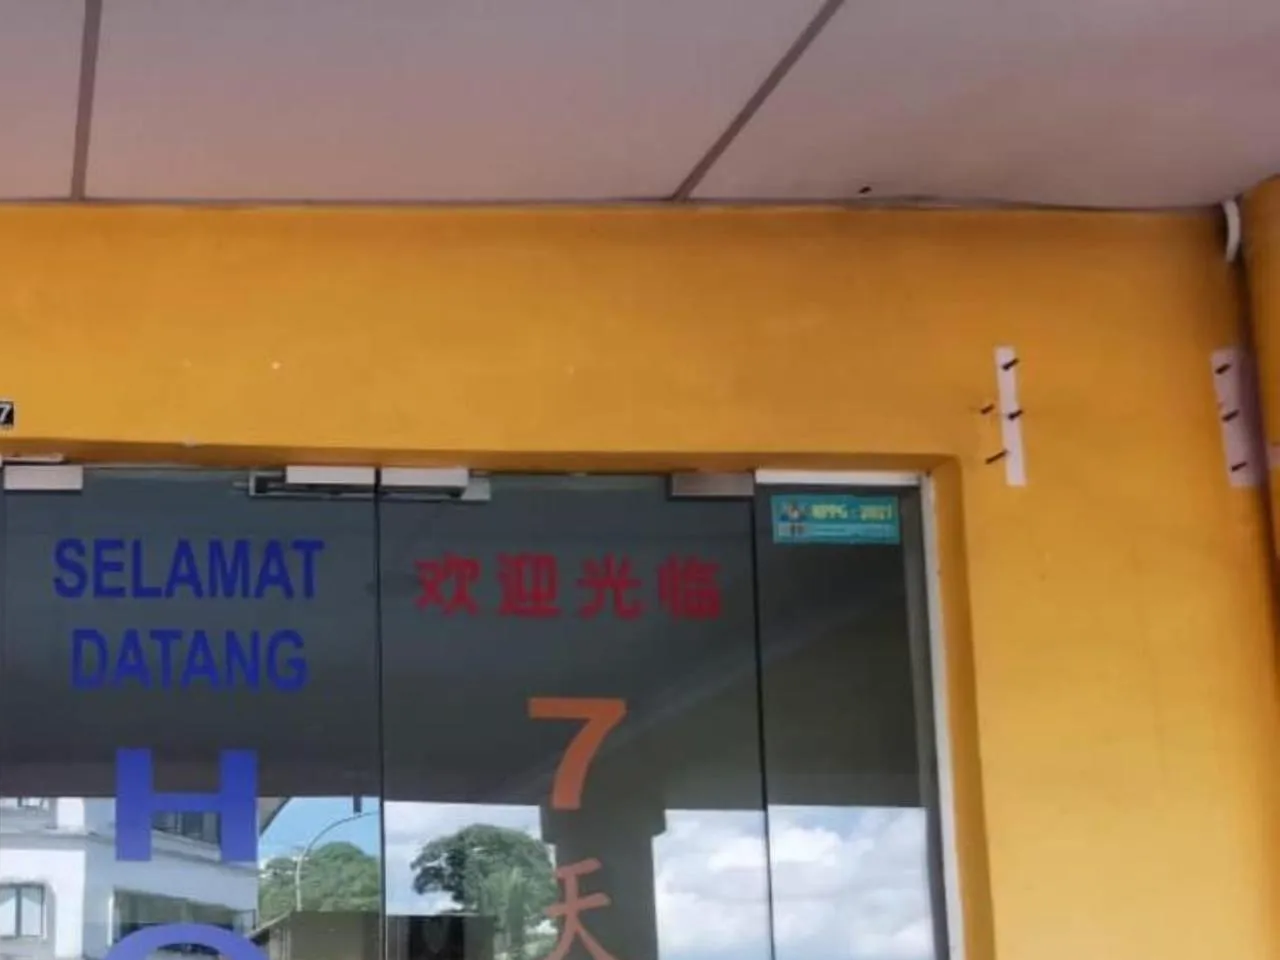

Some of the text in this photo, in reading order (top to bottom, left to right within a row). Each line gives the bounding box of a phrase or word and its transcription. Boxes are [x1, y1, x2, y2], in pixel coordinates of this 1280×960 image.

[52, 537, 326, 599] SELAMAT
[413, 551, 725, 622] 欢迎光临
[72, 628, 310, 692] DATANG
